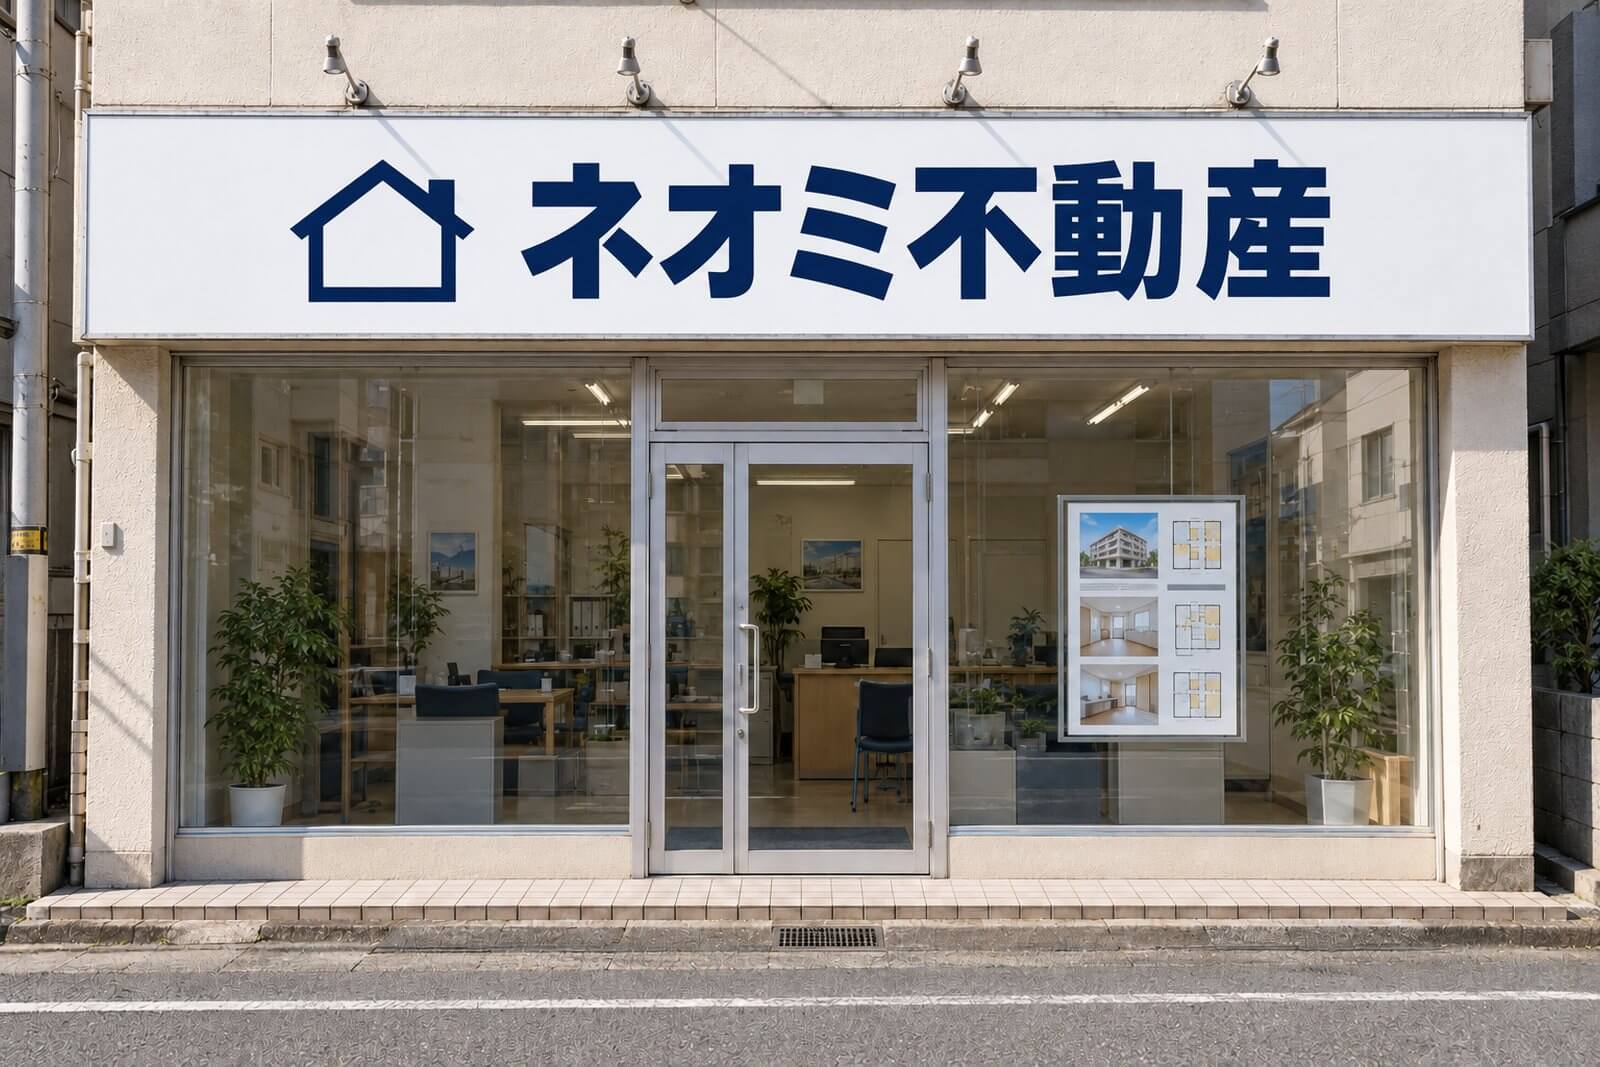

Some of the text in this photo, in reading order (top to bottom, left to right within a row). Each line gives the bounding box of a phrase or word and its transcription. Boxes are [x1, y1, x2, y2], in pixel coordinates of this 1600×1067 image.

[521, 158, 1331, 301] ネオミ不動産
